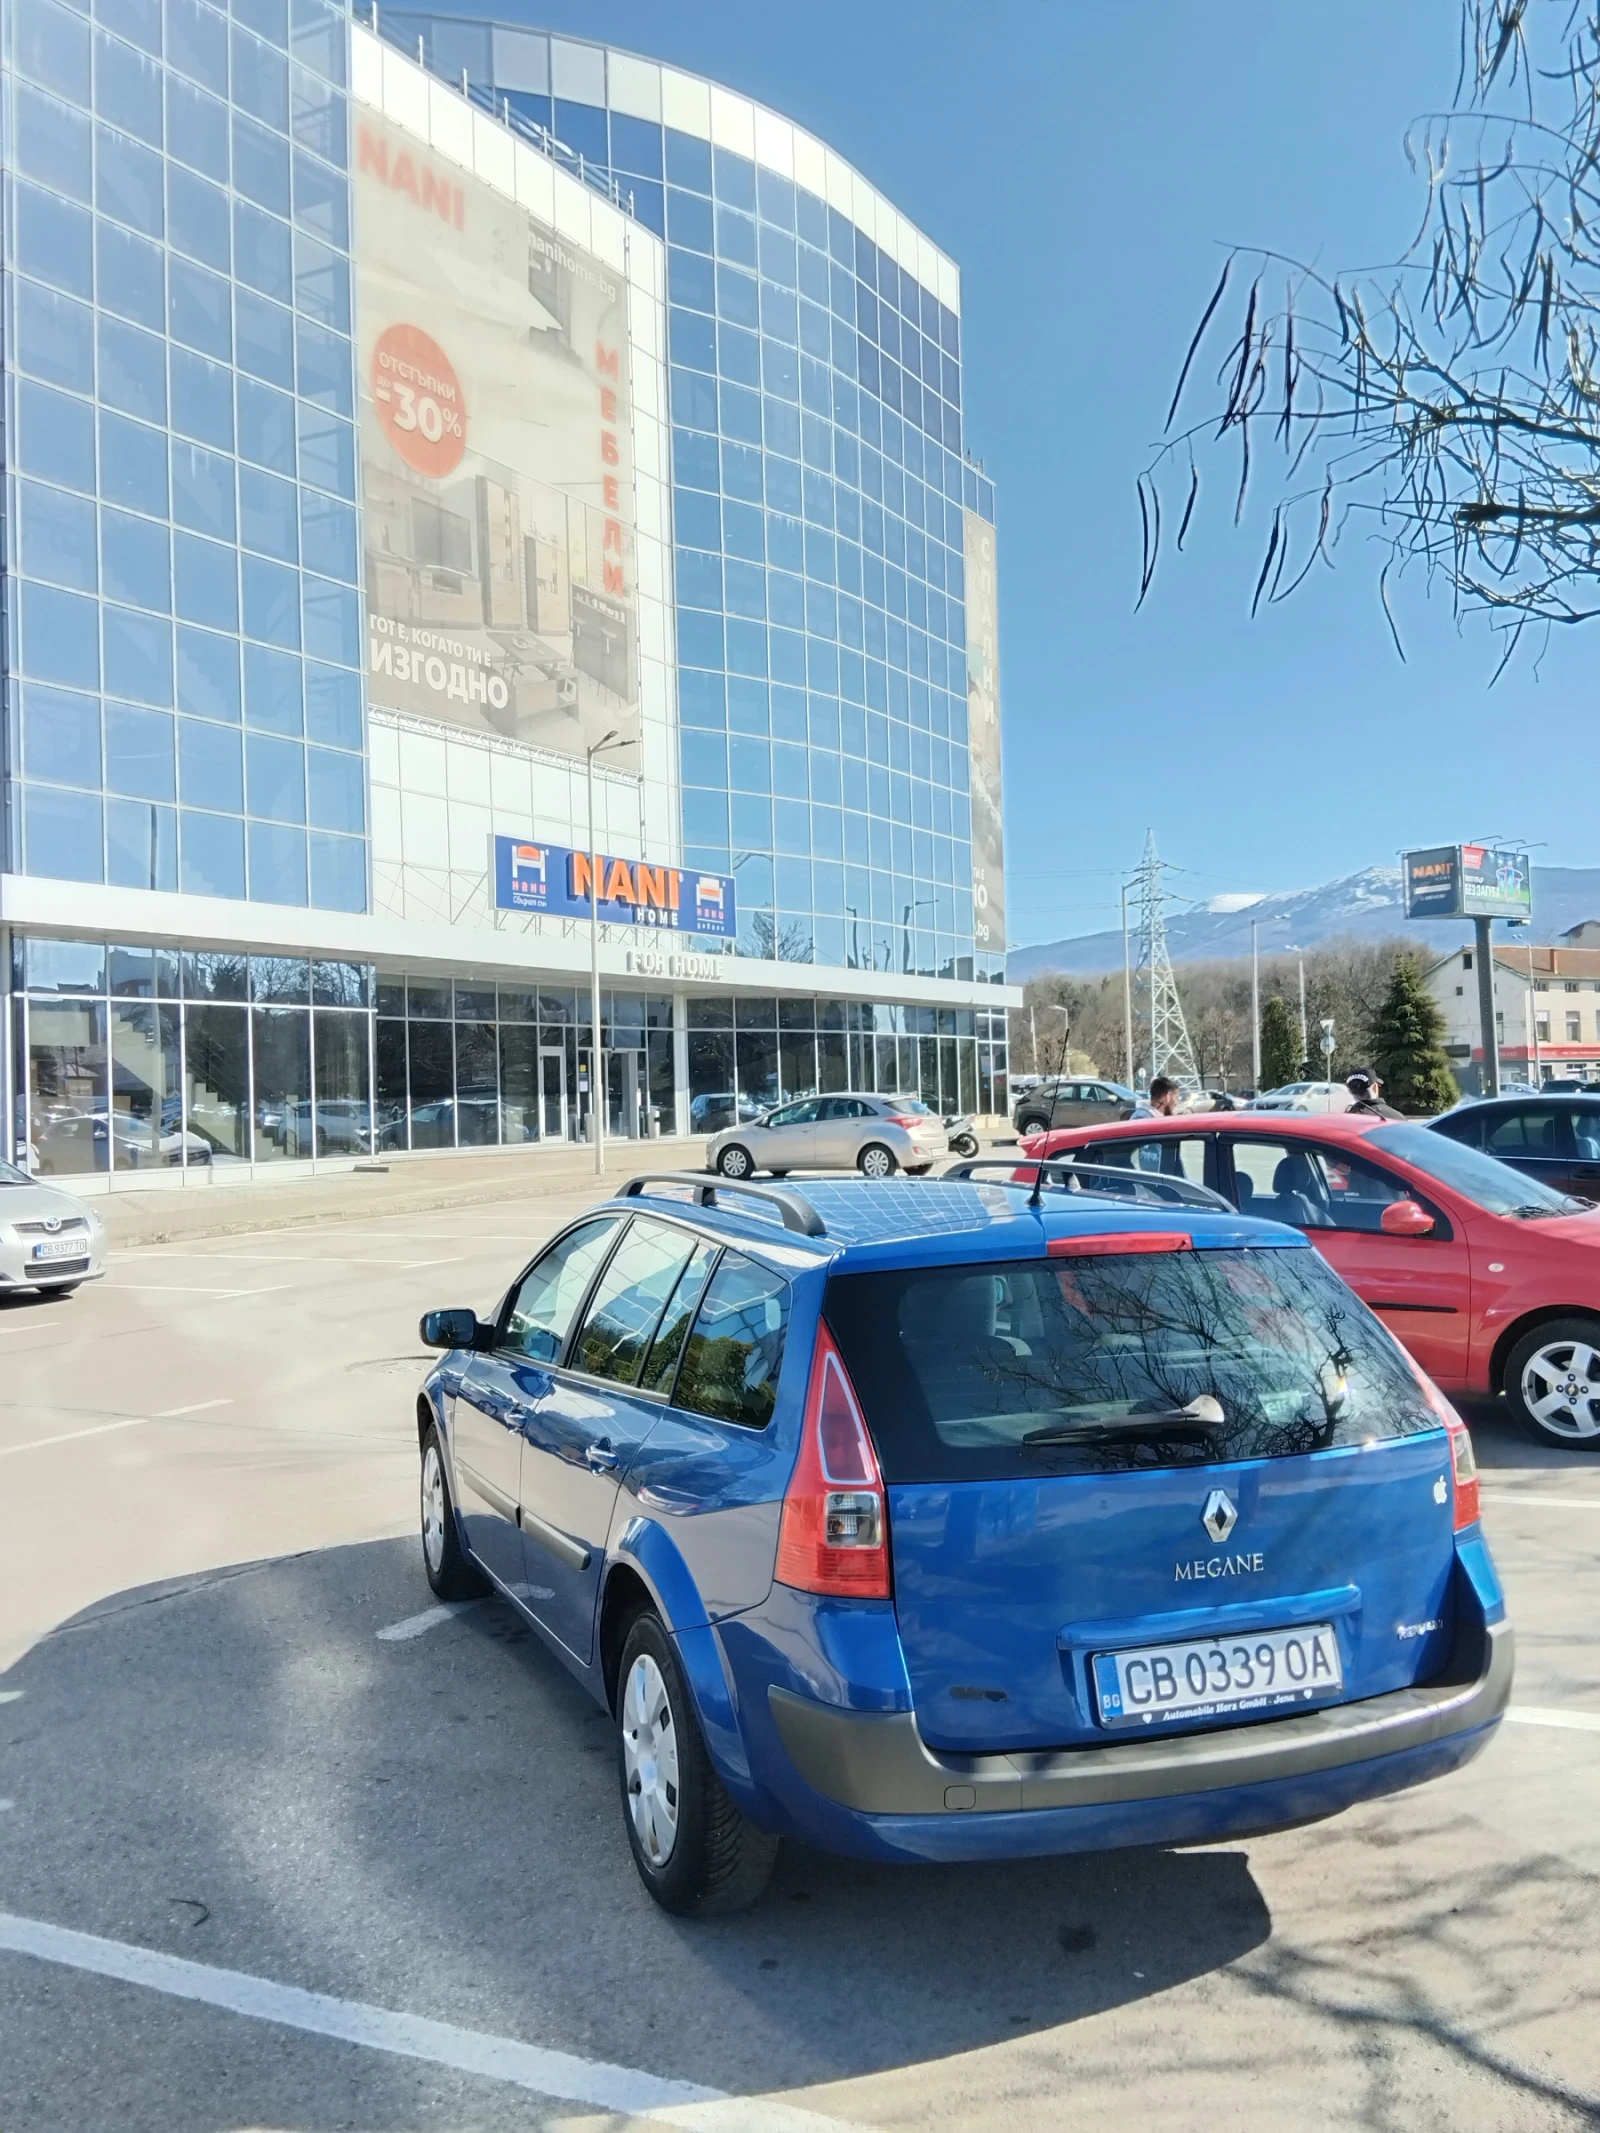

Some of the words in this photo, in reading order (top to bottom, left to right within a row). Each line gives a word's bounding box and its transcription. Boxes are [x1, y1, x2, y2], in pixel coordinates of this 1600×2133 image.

[357, 126, 464, 231] NANI
[528, 231, 616, 303] nanihome.bg
[379, 351, 456, 403] ОТСТЪПКИ
[596, 342, 624, 599] МЕБЕЛИ
[370, 613, 396, 636] ГОТ
[412, 627, 463, 658] КОГАТО
[465, 645, 482, 664] ТИ
[484, 651, 491, 667] Е
[370, 637, 508, 709] ИЗГОДНО
[572, 851, 679, 910] NANI
[637, 907, 678, 926] HOME
[628, 951, 665, 975] FOR
[669, 956, 725, 979] HOME
[1174, 1553, 1264, 1581] MEGANE
[1103, 1694, 1120, 1709] BG
[1125, 1656, 1178, 1705] CB
[1186, 1643, 1276, 1696] 0339
[1163, 1705, 1214, 1720] Automobile
[1216, 1702, 1238, 1714] Herz
[1239, 1696, 1267, 1709] GmbH
